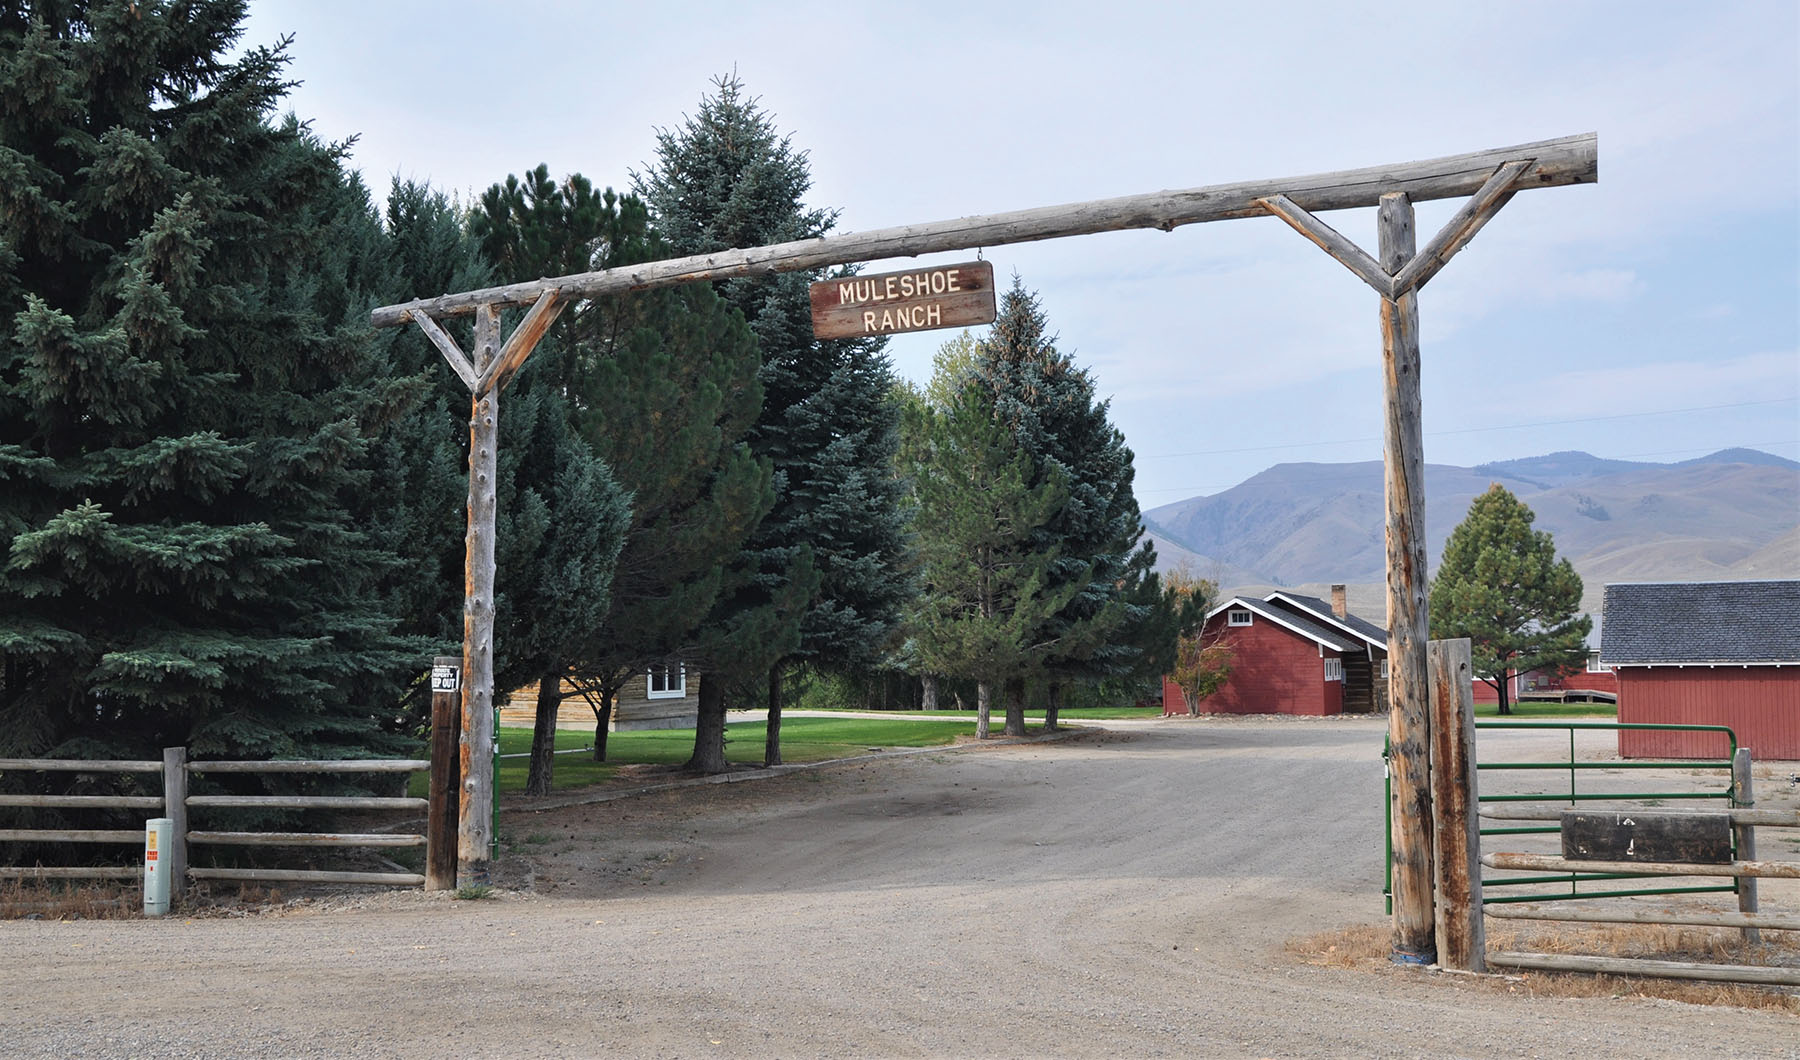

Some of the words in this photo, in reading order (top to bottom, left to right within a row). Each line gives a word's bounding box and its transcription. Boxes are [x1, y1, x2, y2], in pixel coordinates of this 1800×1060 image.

[839, 270, 961, 304] MULESHOE
[864, 304, 941, 332] RANCH
[442, 678, 456, 689] OUT
